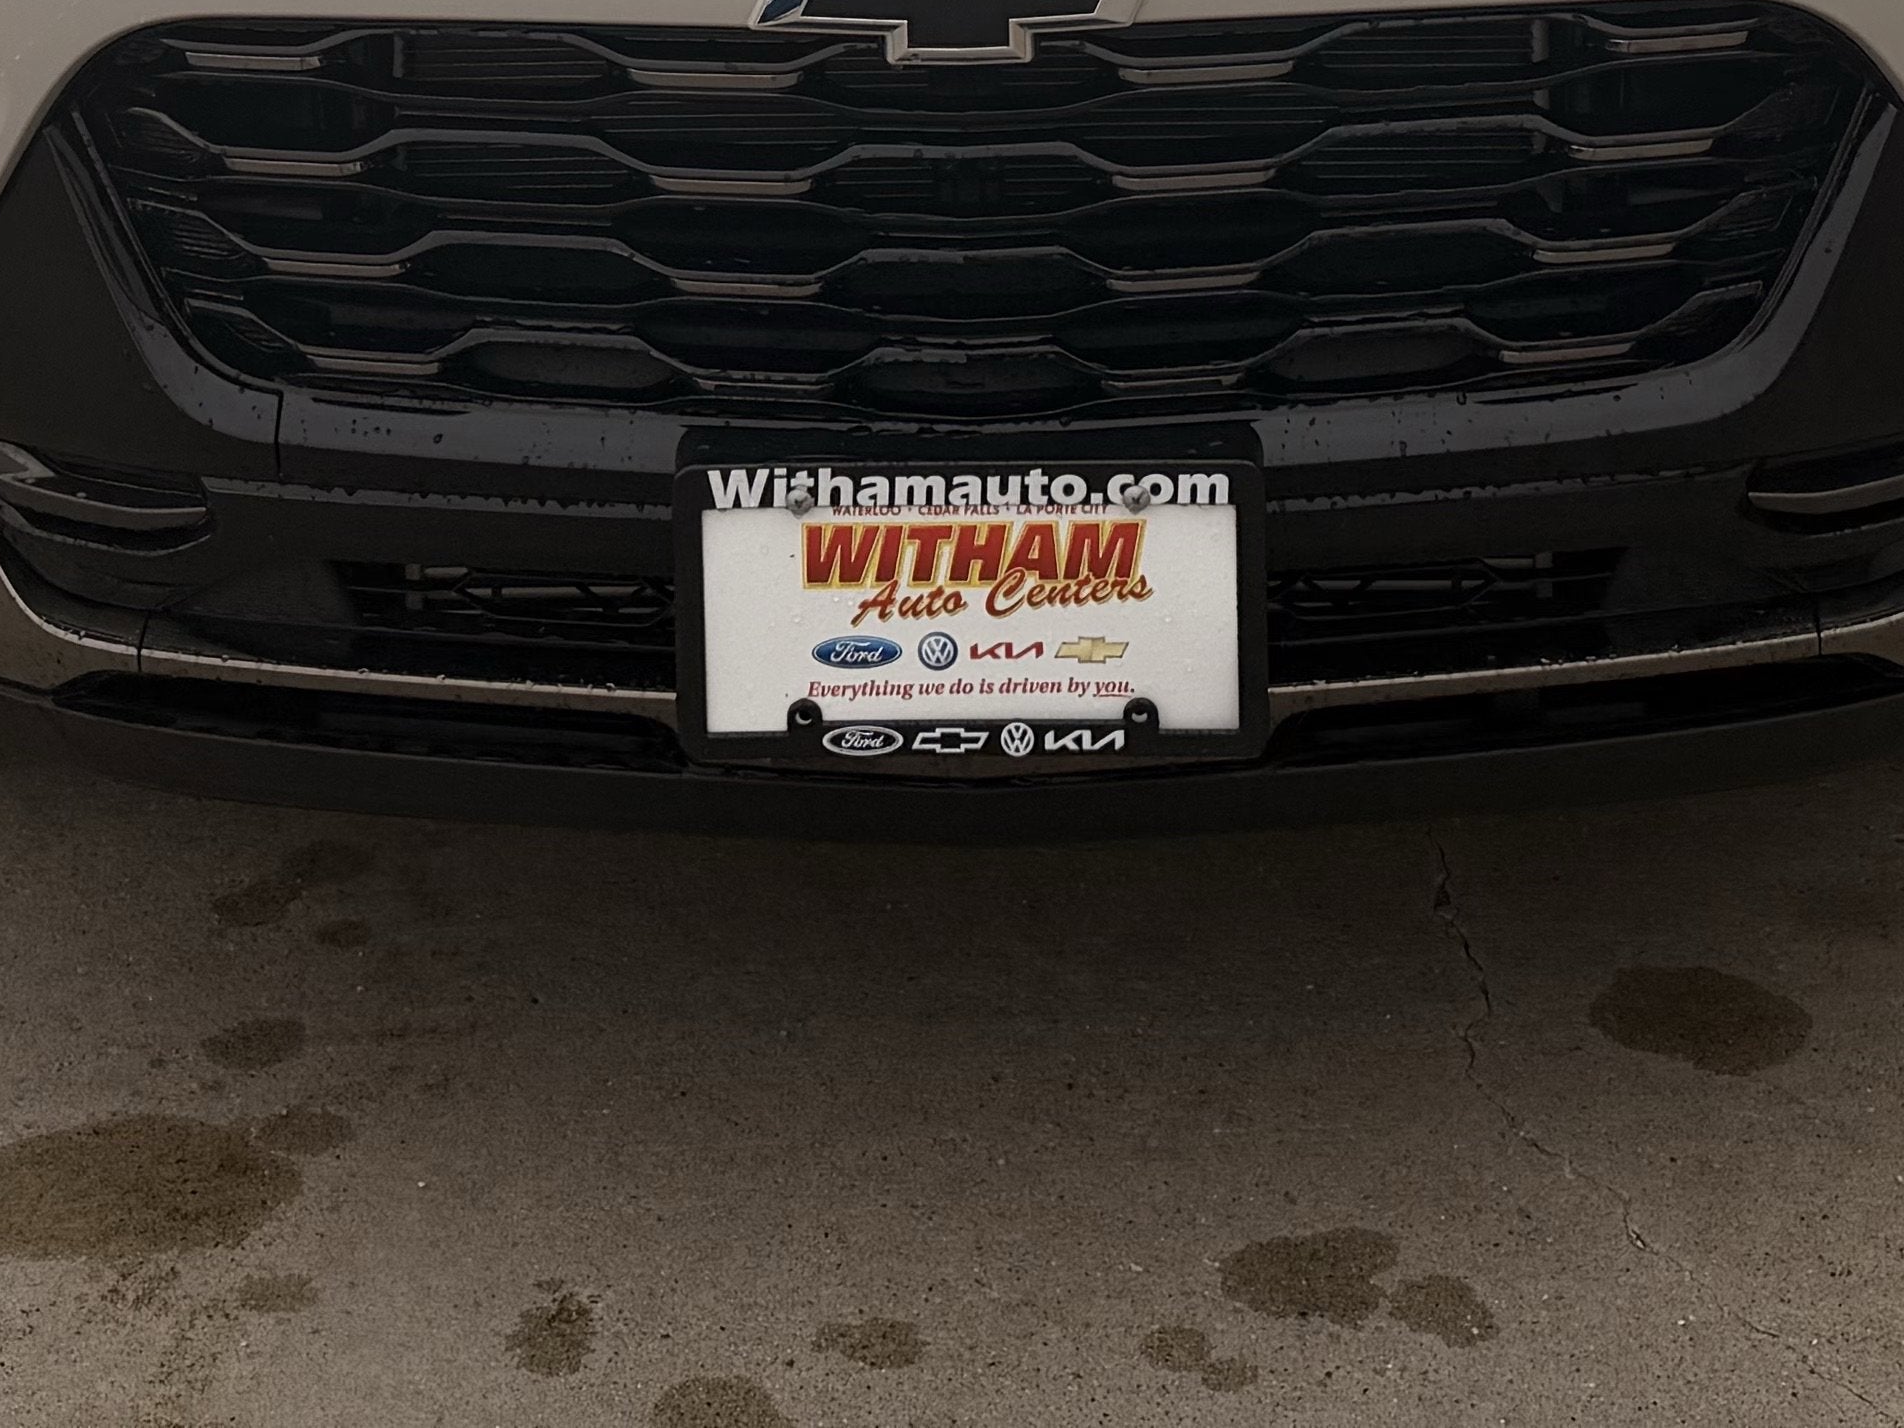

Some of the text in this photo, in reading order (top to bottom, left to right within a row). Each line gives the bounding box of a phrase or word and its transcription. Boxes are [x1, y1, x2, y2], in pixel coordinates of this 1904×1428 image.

[707, 467, 1229, 508] Withamauto.com
[832, 505, 902, 516] WATERLOO
[801, 520, 1147, 589] WITHAM
[850, 566, 1155, 628] Auto Centers
[829, 640, 883, 663] Ford
[970, 641, 1044, 660] KIA
[808, 676, 1135, 701] Everything we do is driven by you.
[1044, 729, 1125, 751] KIA
